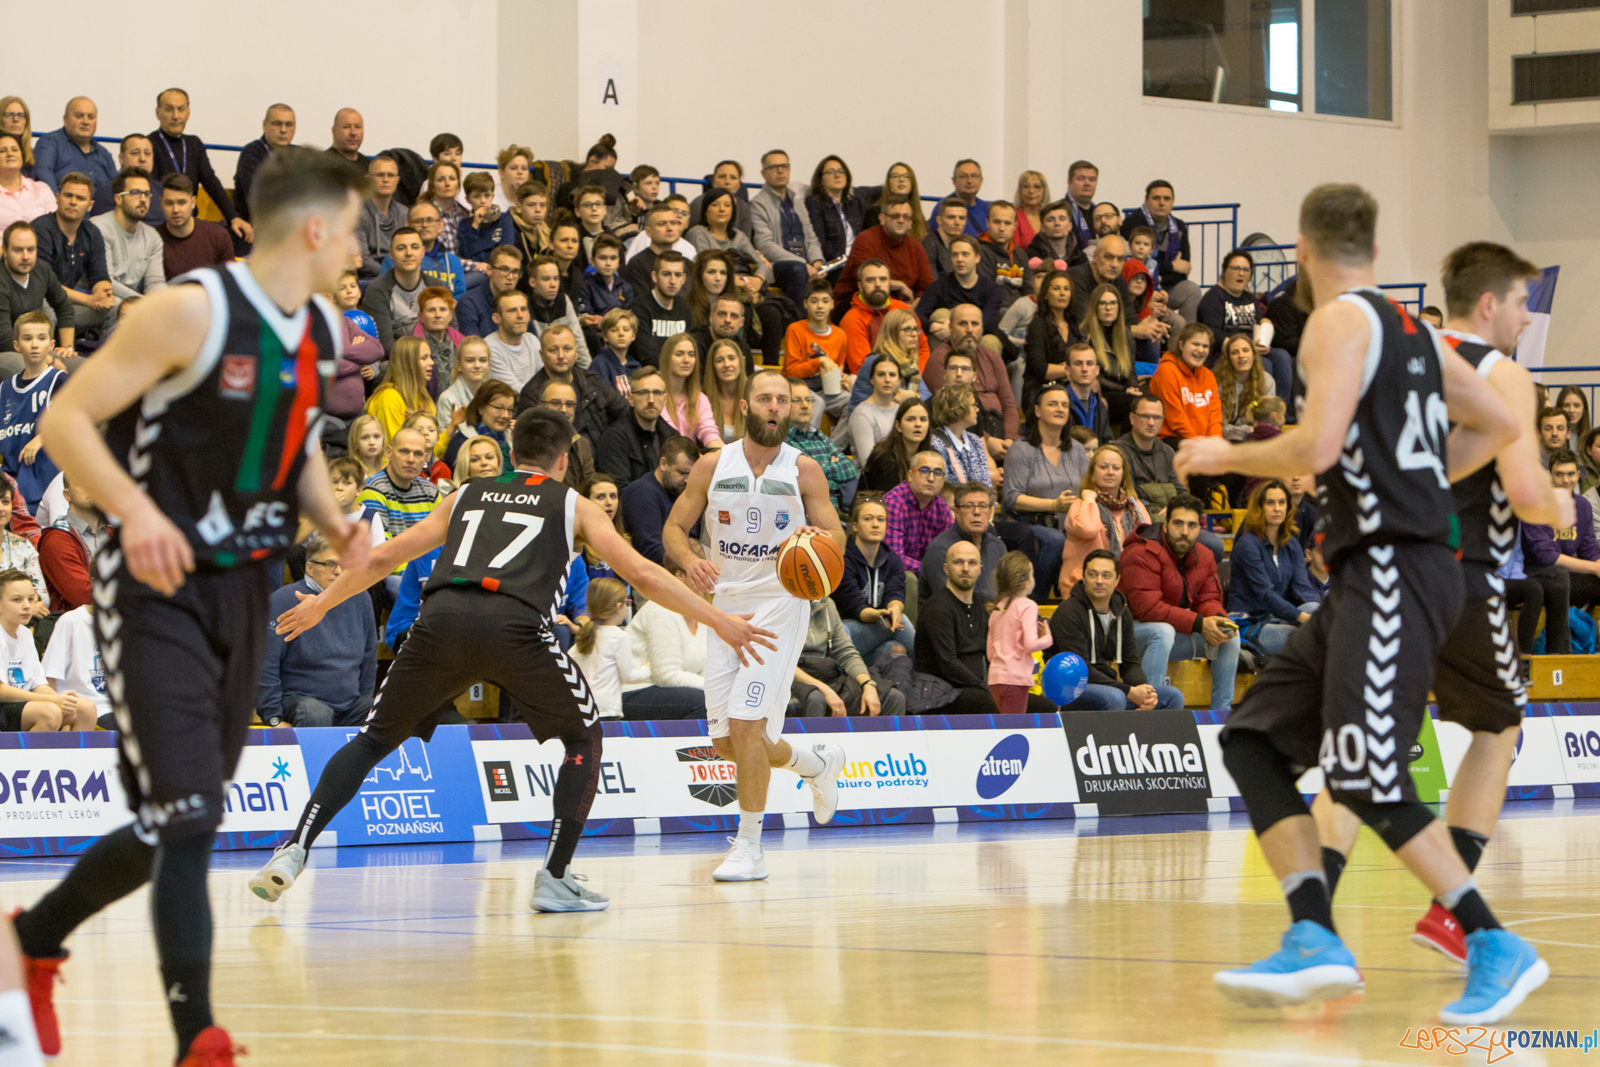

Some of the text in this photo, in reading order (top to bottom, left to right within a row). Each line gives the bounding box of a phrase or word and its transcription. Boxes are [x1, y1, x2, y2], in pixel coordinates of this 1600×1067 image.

[602, 78, 619, 106] A
[651, 319, 686, 337] PUMA
[481, 491, 541, 506] KULON
[718, 482, 746, 490] macron
[746, 507, 762, 533] 9
[453, 509, 545, 569] 17
[800, 564, 819, 597] molten
[473, 685, 480, 698] 8
[745, 681, 765, 707] 9
[688, 747, 719, 759] SECUR
[1076, 733, 1204, 776] drukma
[1318, 723, 1367, 774] 40
[524, 761, 636, 796] NIEL
[838, 753, 927, 779] unclub
[981, 755, 1023, 776] atrem
[837, 777, 928, 789] biuro podróży
[1084, 774, 1207, 793] DRUKARNIA SKOCZYŃSKI
[222, 782, 289, 813] nan
[360, 789, 440, 820] HOTEL
[6, 809, 100, 820] PRODUCENT LEKÓW
[366, 820, 444, 836] POZNAŃSKI
